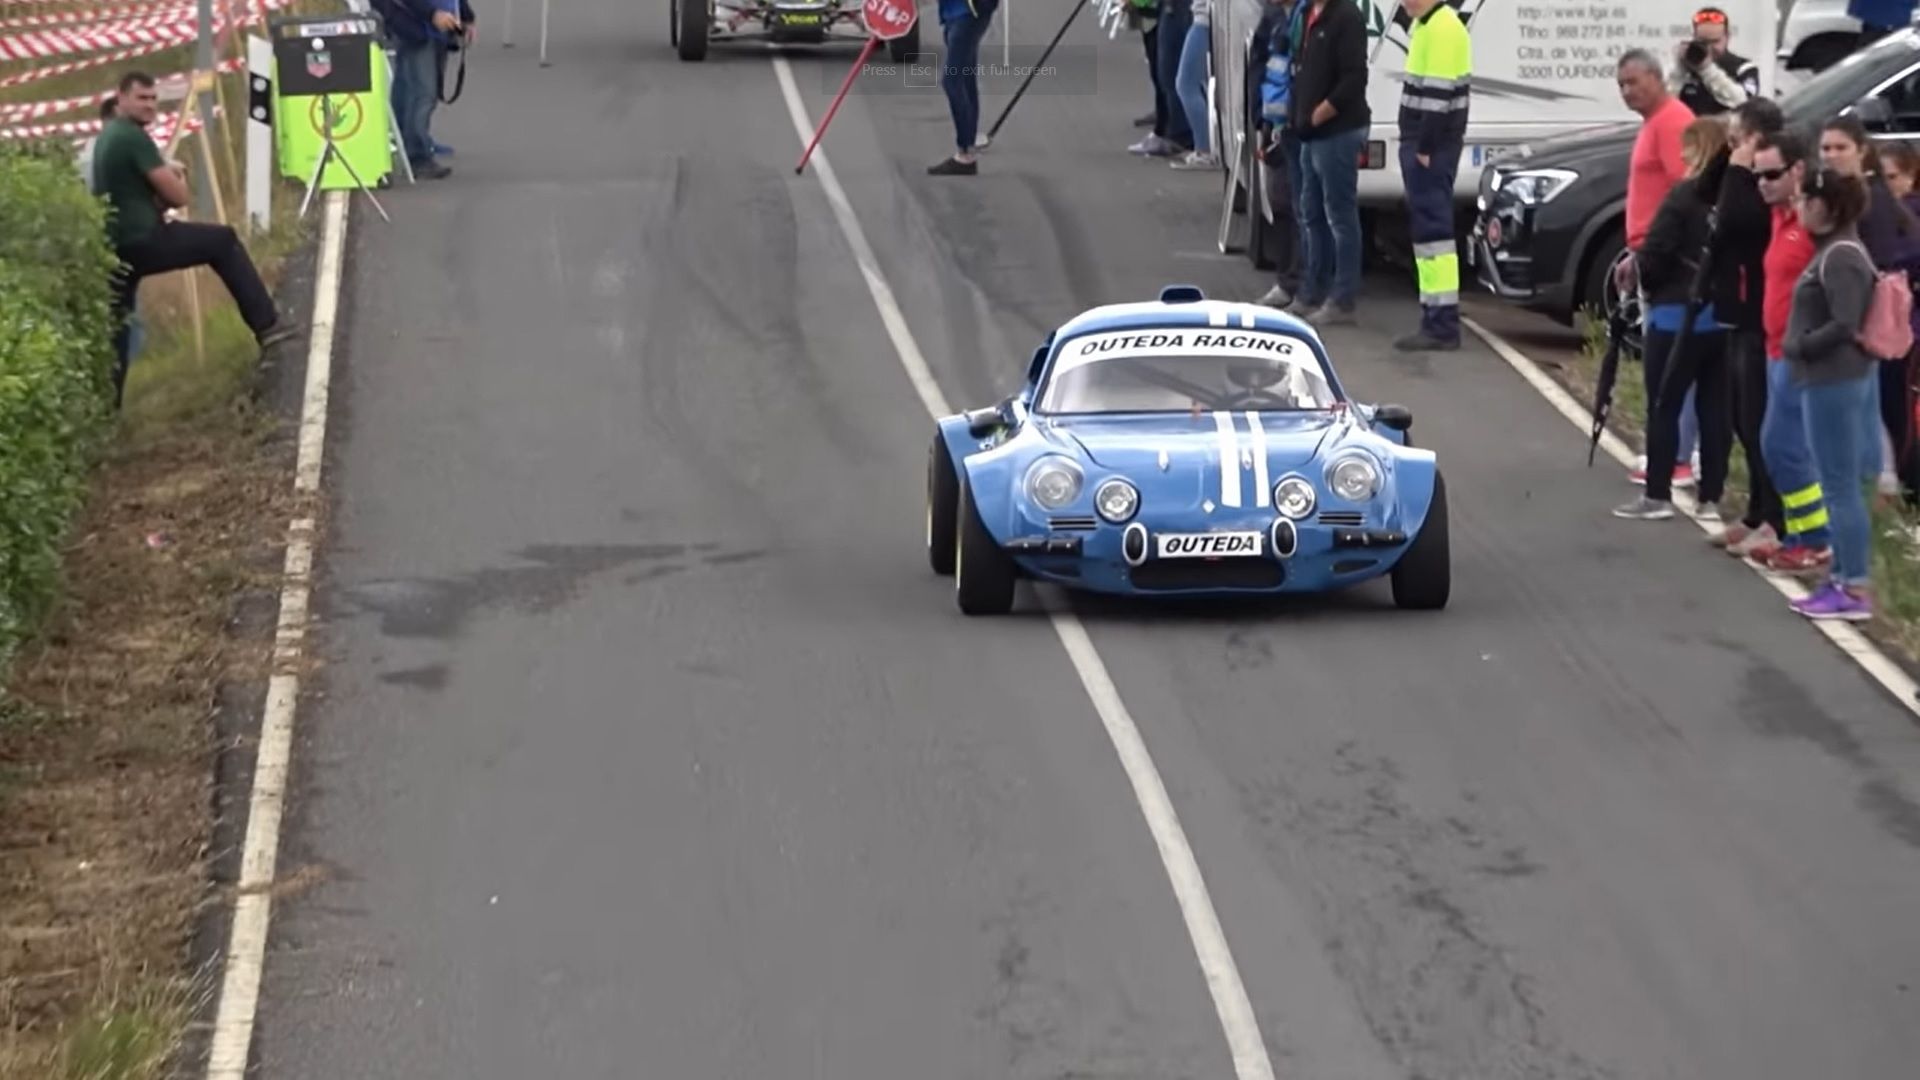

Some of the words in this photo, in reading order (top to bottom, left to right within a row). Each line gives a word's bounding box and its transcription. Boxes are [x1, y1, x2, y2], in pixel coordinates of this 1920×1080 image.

[866, 0, 910, 26] STOP
[1080, 335, 1184, 356] OUTEDA
[1192, 335, 1294, 355] RACING
[1165, 536, 1255, 554] OUTEDA
